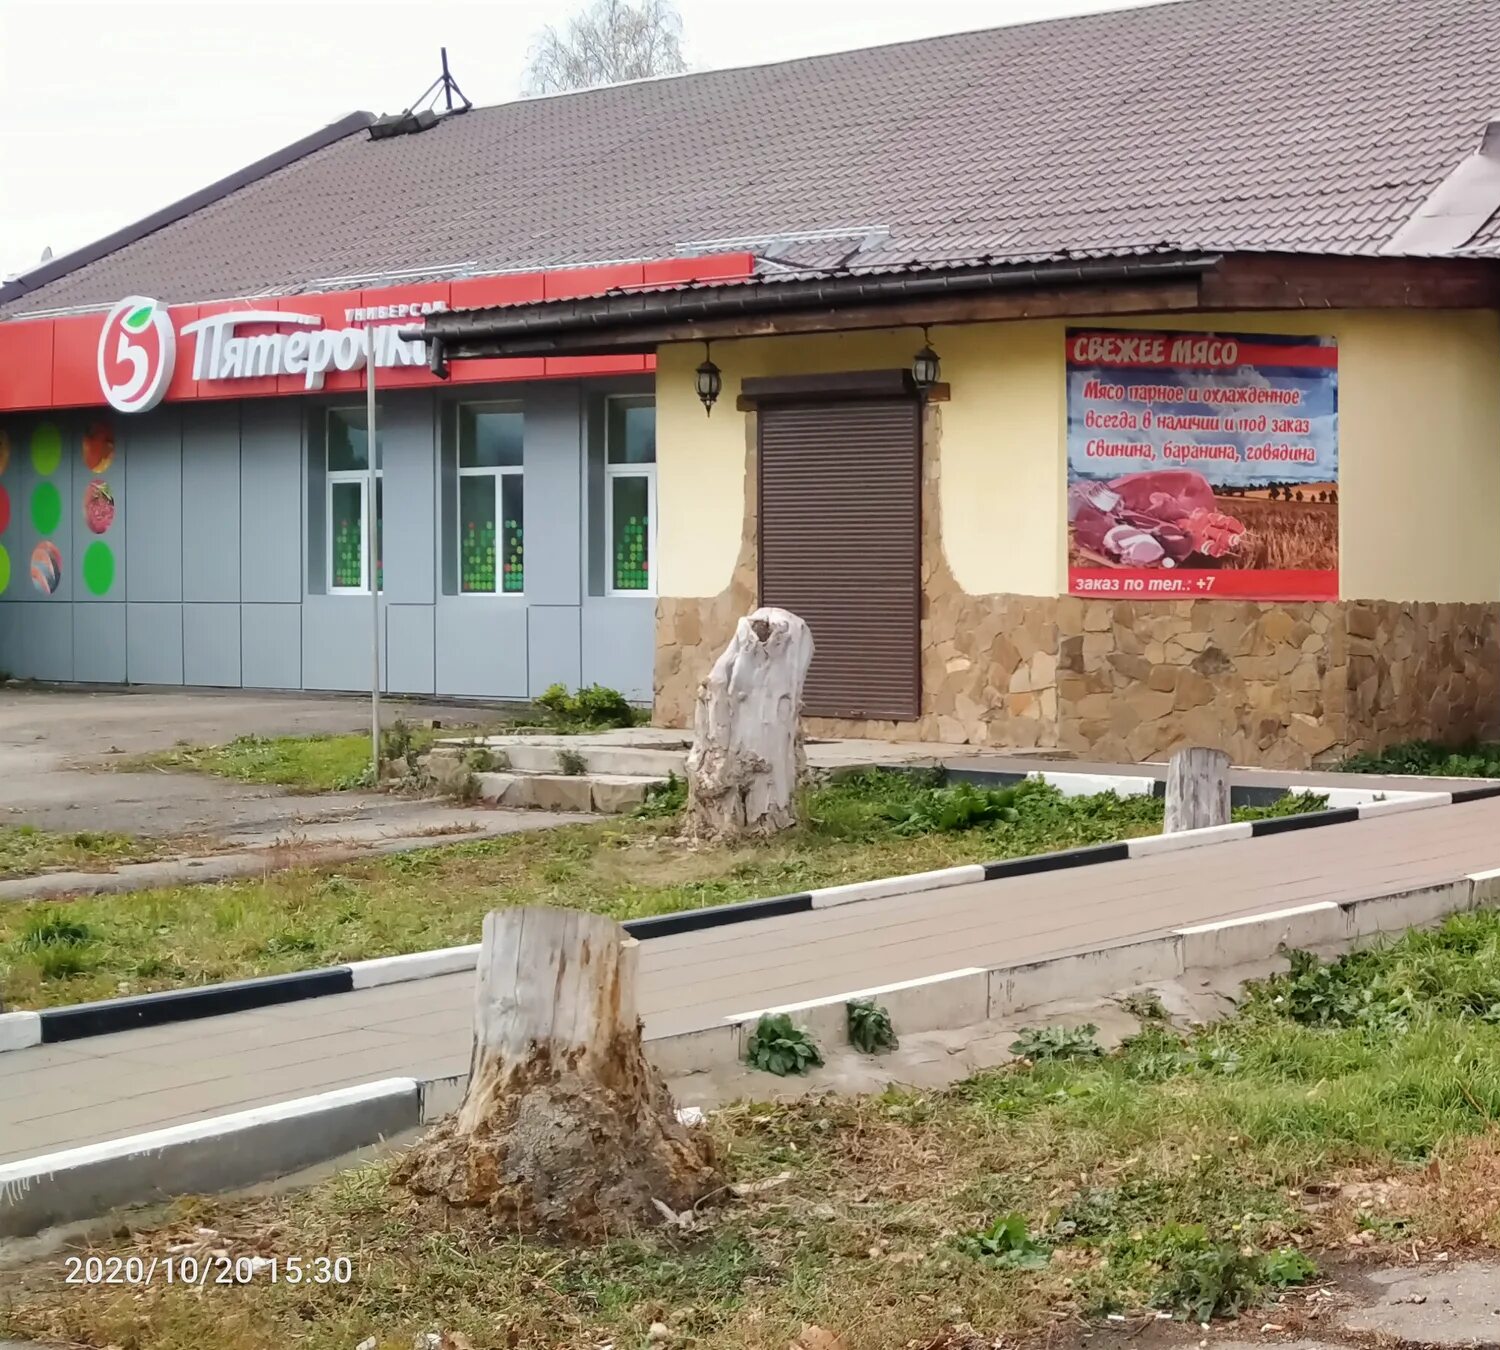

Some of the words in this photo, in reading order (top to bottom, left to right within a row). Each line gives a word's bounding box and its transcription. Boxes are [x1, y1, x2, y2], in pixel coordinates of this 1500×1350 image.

[1073, 337, 1165, 363] СВЕЖЕЕ
[1171, 340, 1238, 365] МЯСО
[1083, 380, 1124, 400] Мясо
[1129, 387, 1184, 405] парное
[1188, 390, 1198, 402] и
[1085, 411, 1137, 429] всегда
[1142, 411, 1151, 429] в
[1157, 417, 1220, 430] наличии
[1225, 419, 1235, 430] и
[1239, 416, 1266, 432] под
[1271, 420, 1310, 433] заказ
[1086, 441, 1157, 461] Свинина,
[1163, 441, 1241, 463] баранина,
[1246, 445, 1316, 462] говядина
[1075, 578, 1119, 590] заказ
[1124, 580, 1144, 590] по
[1196, 576, 1216, 591] +7
